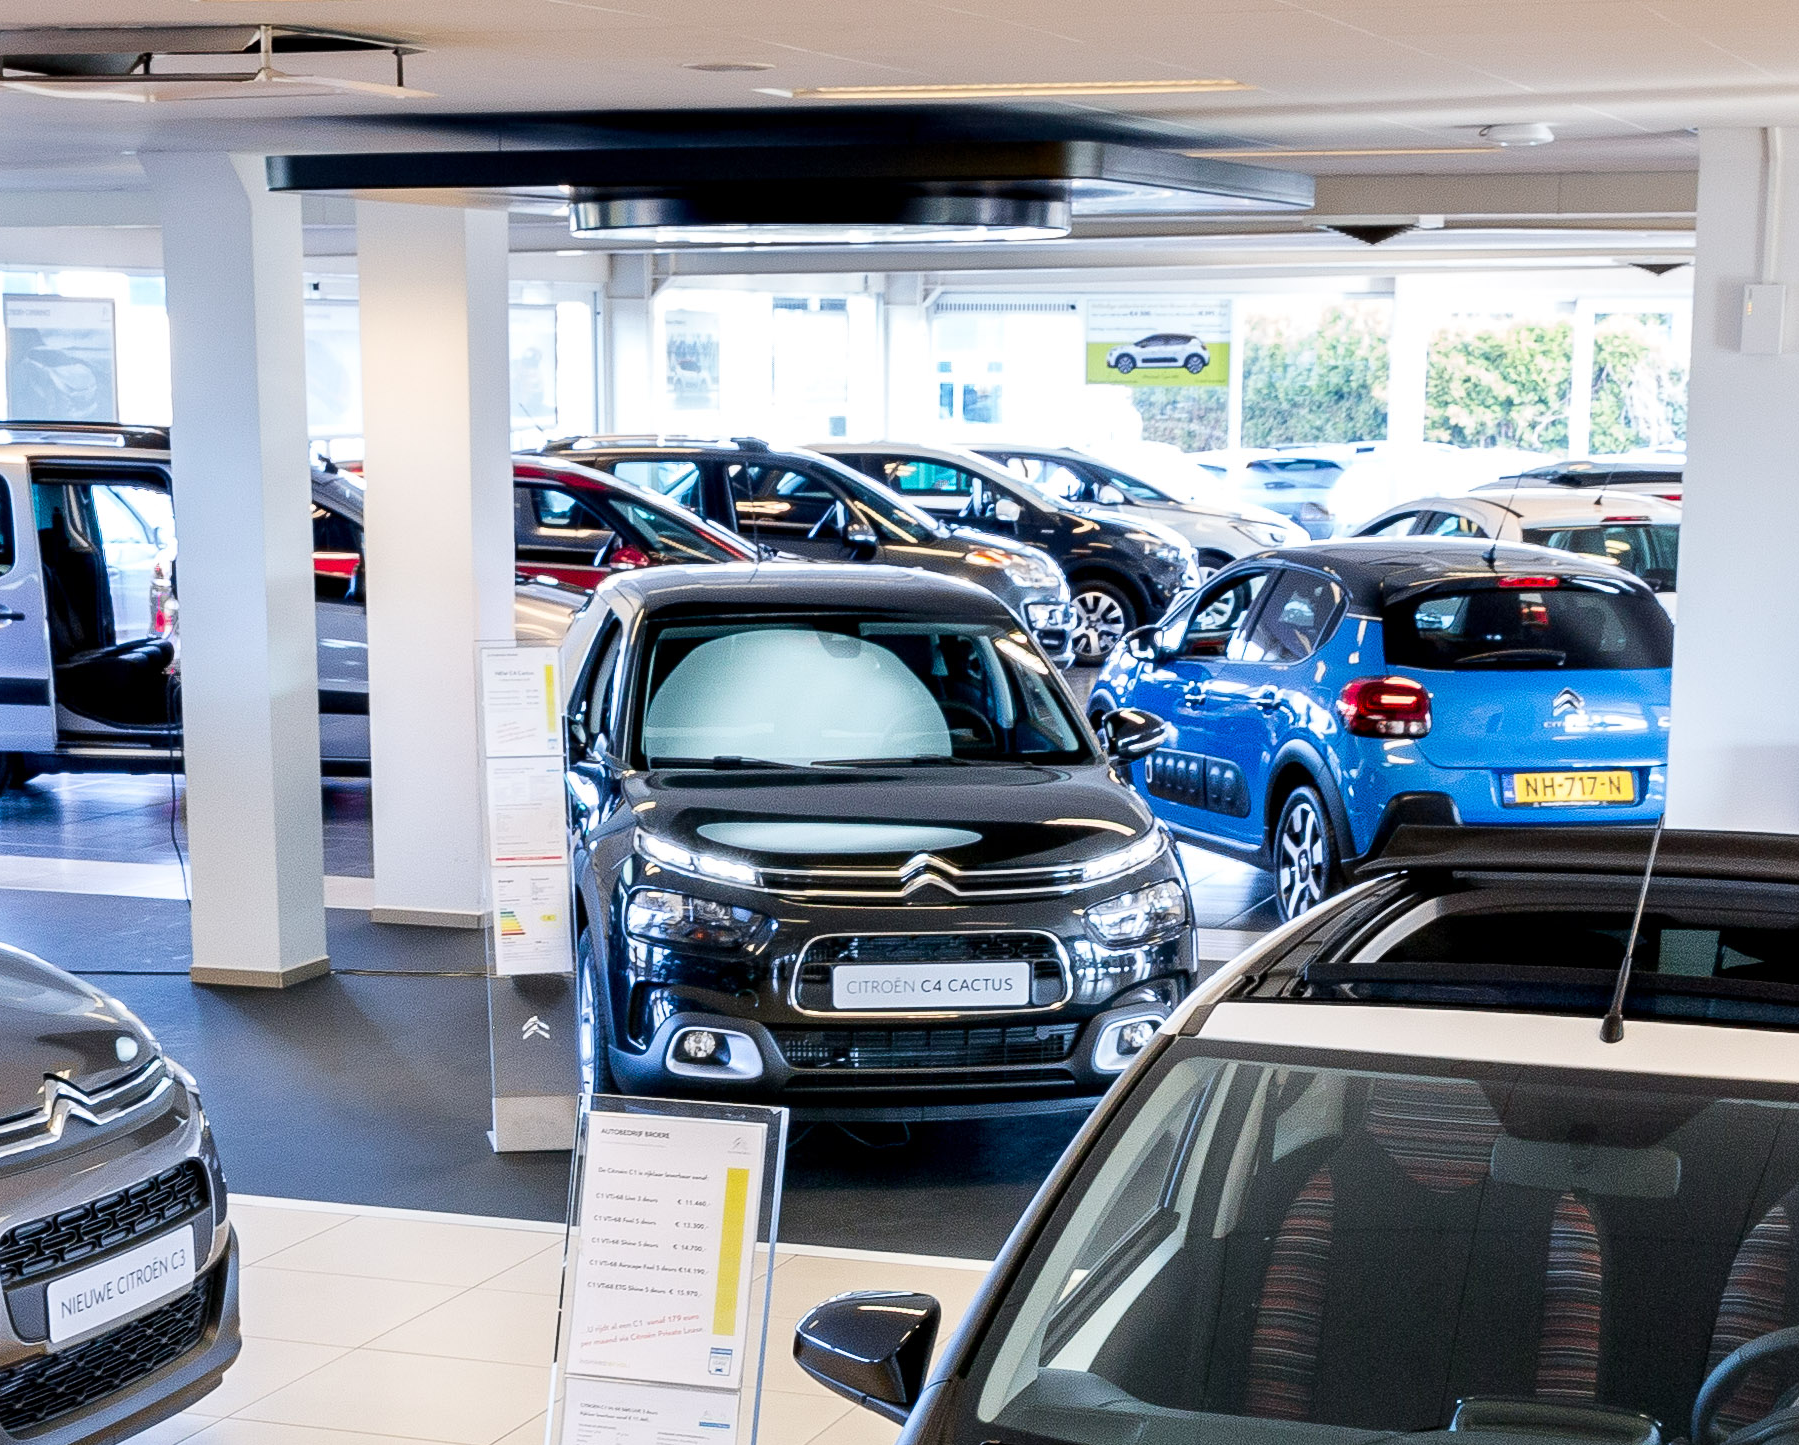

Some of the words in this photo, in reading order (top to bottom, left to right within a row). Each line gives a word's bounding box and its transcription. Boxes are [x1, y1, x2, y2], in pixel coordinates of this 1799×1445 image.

[1525, 776, 1622, 798] NH-717-N
[846, 976, 915, 994] CITROËN
[920, 979, 942, 993] C4
[947, 977, 1013, 992] CACTUS
[60, 1281, 114, 1319] NIEUWE
[116, 1256, 169, 1295] CITROËN
[170, 1249, 186, 1271] C3
